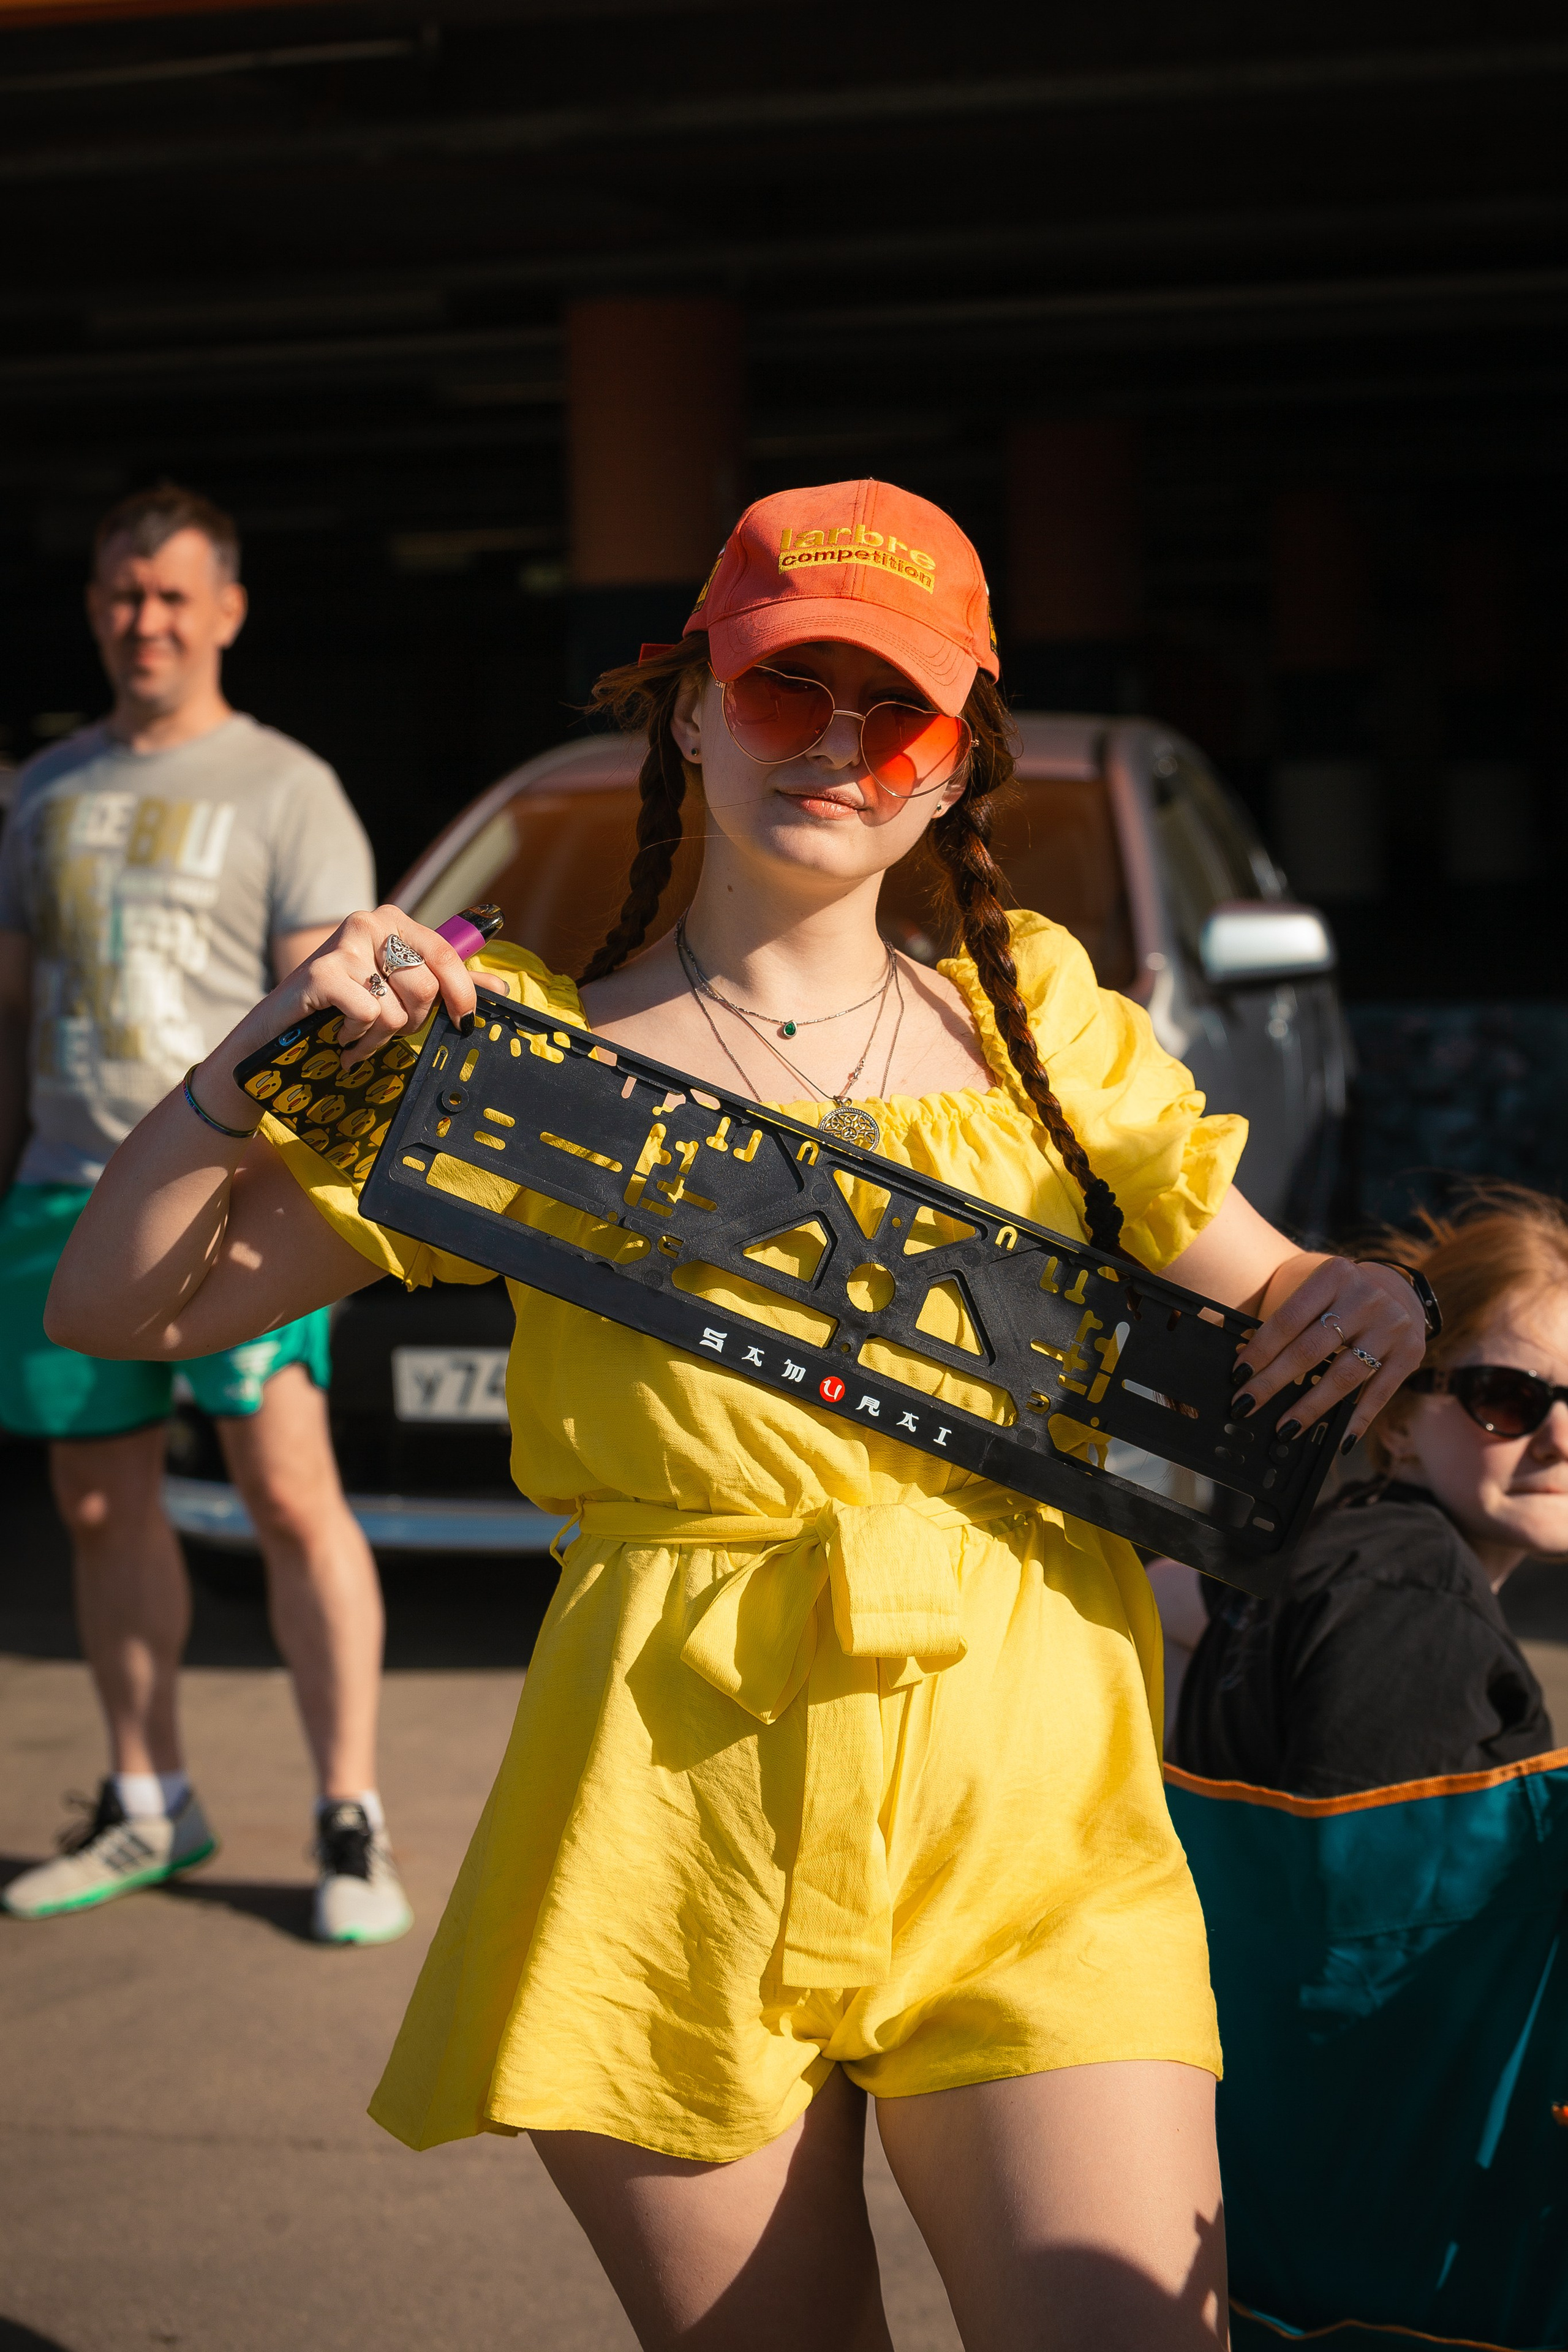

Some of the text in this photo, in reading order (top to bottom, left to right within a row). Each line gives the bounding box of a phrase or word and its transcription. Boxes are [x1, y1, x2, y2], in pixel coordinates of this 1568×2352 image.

[781, 525, 936, 570] larbre
[782, 549, 931, 587] competition
[699, 1327, 951, 1446] SAMURAI
